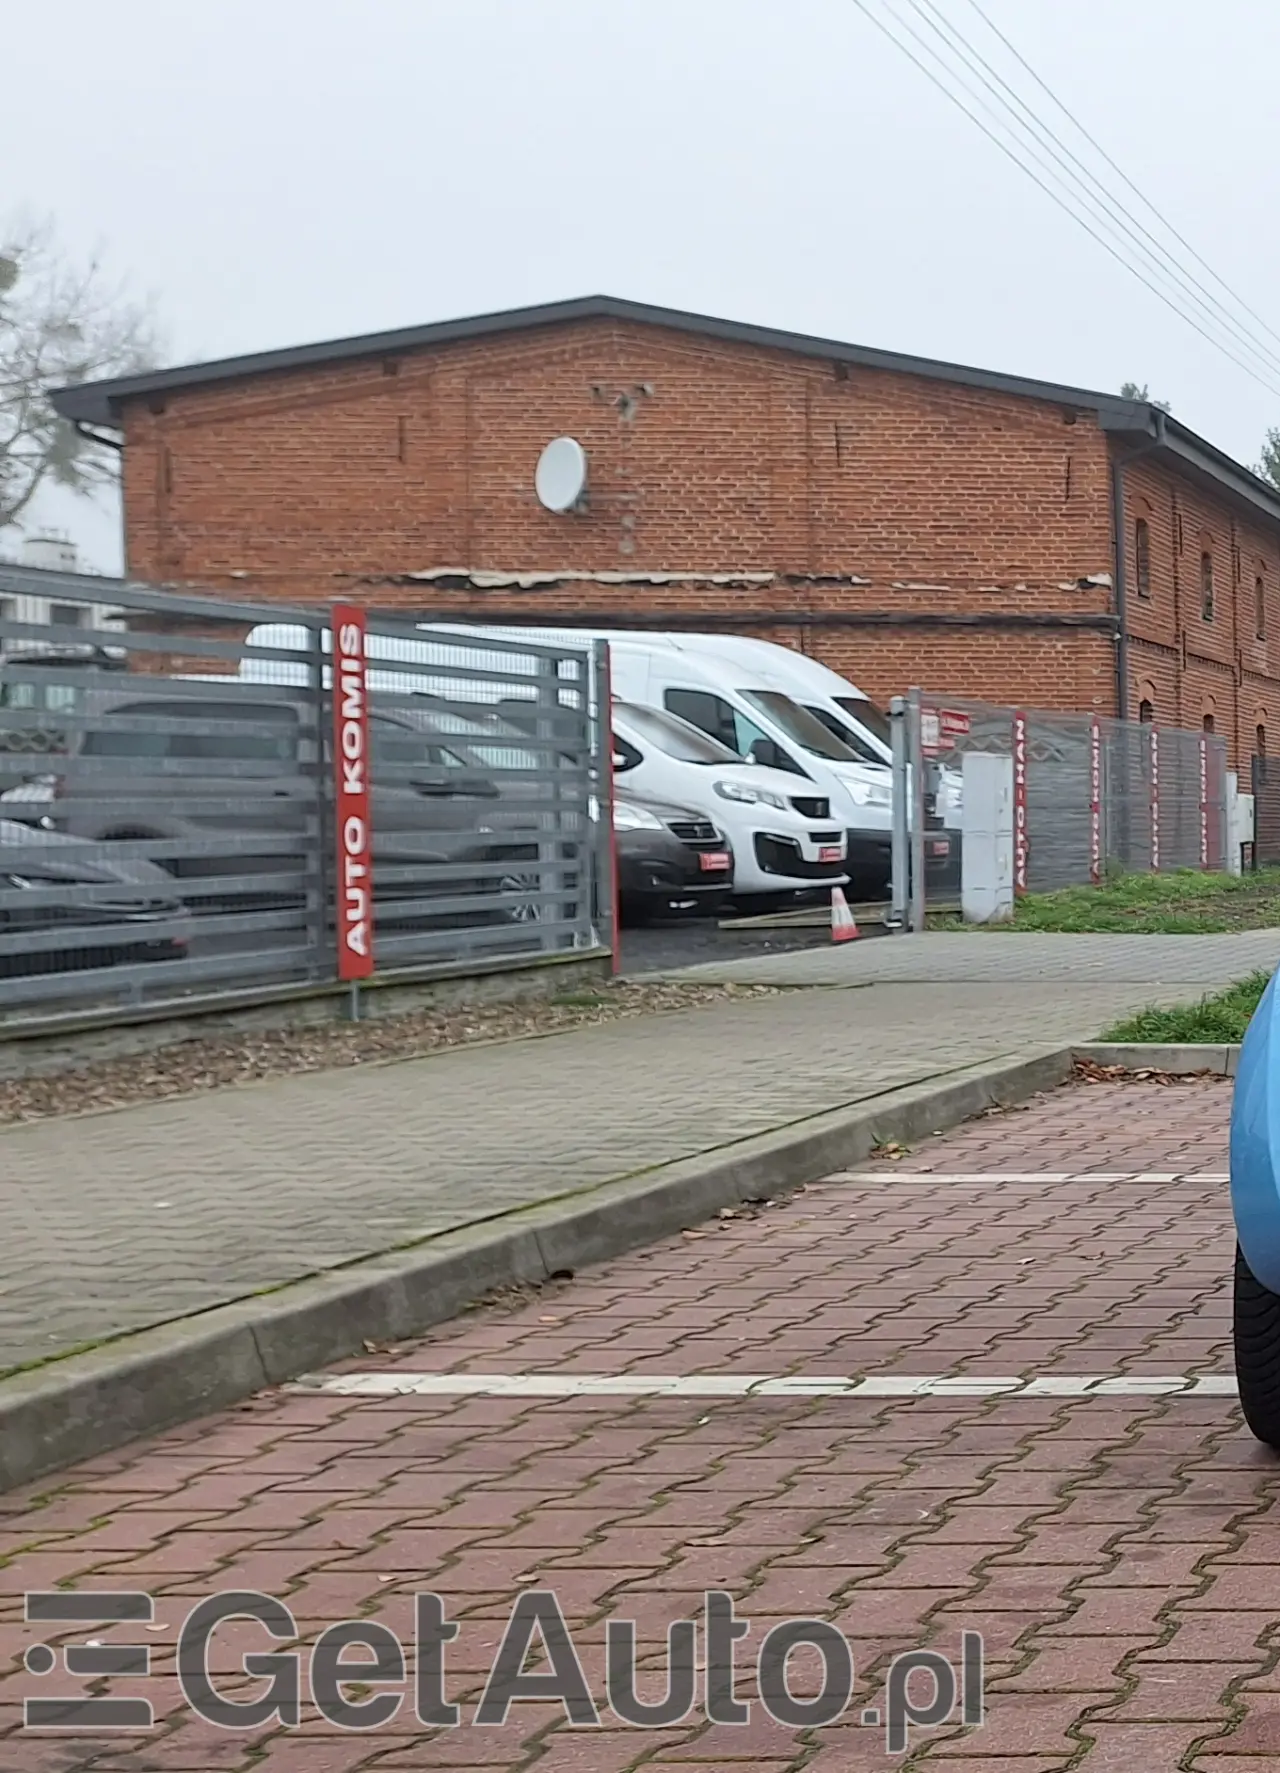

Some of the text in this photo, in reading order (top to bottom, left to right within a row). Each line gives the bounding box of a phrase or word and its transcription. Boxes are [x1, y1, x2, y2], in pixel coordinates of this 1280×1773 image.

[339, 622, 367, 957] AUTO KOMIS
[1016, 719, 1026, 785] HAN
[1016, 805, 1026, 889] AUTO
